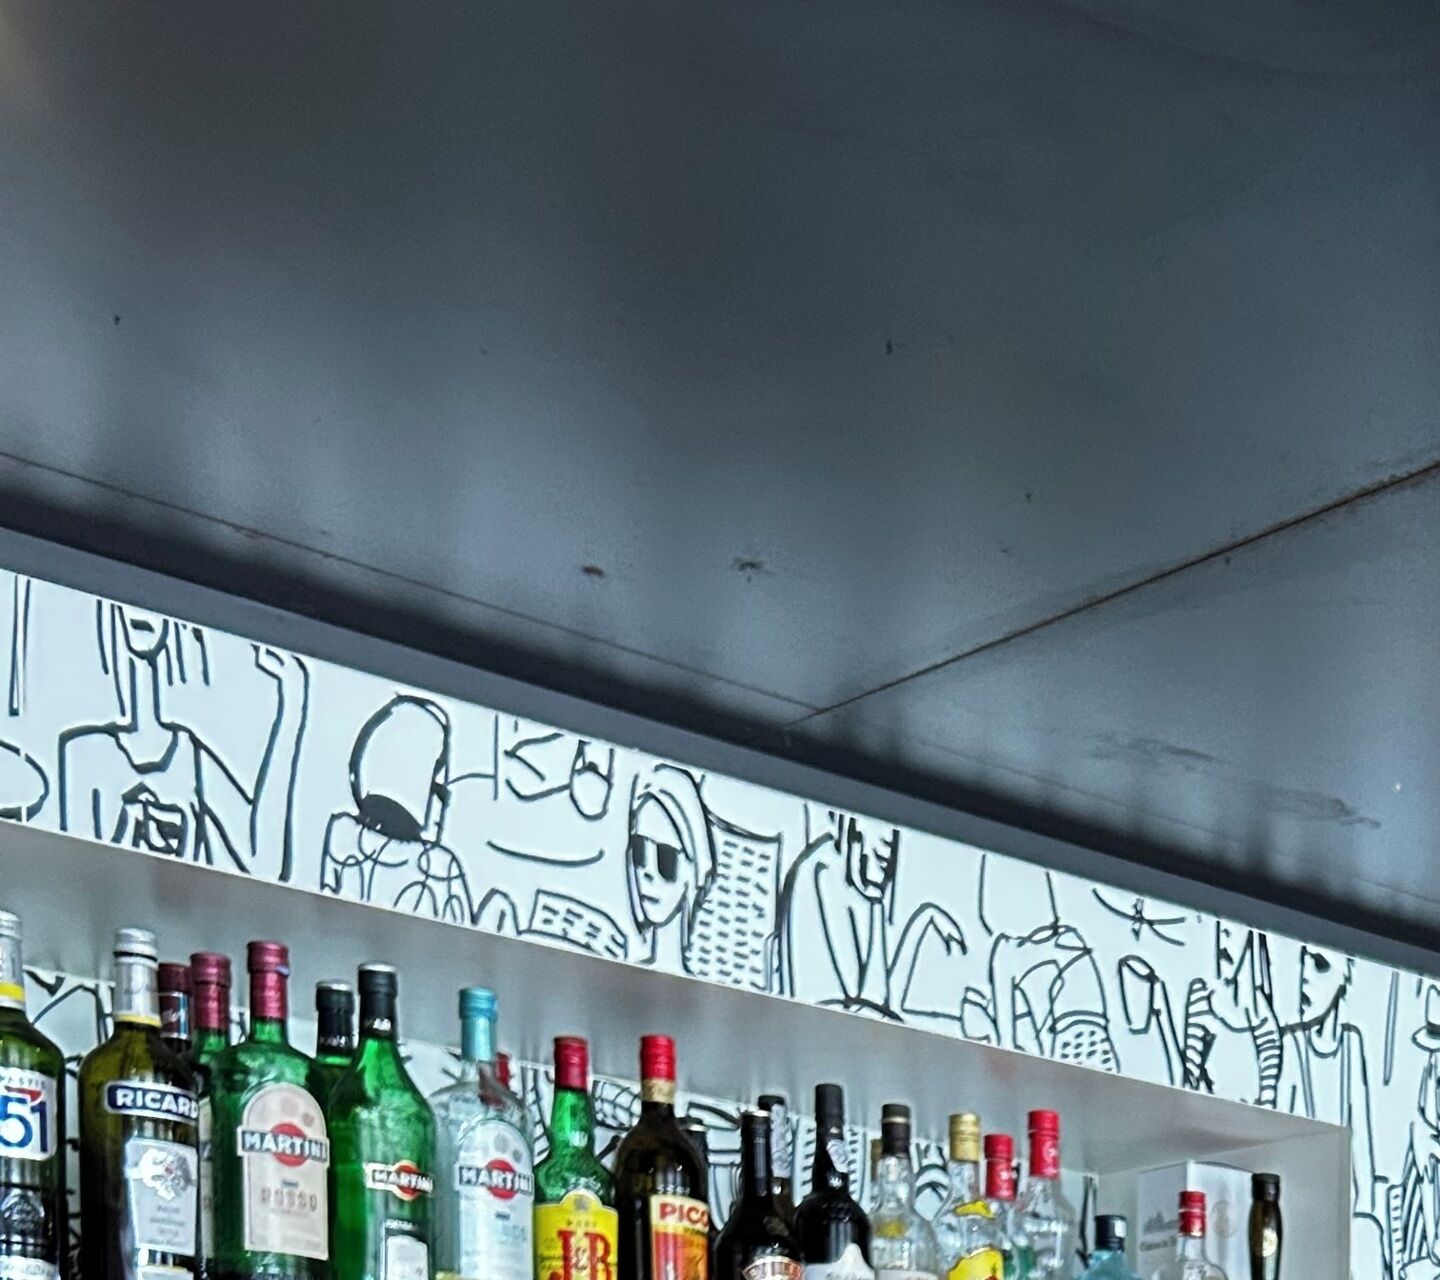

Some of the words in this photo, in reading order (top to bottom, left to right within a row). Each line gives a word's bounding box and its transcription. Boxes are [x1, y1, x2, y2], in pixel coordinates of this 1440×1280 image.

[116, 1088, 198, 1119] RICARD
[0, 1095, 48, 1153] 51
[244, 1132, 327, 1162] MARTINI
